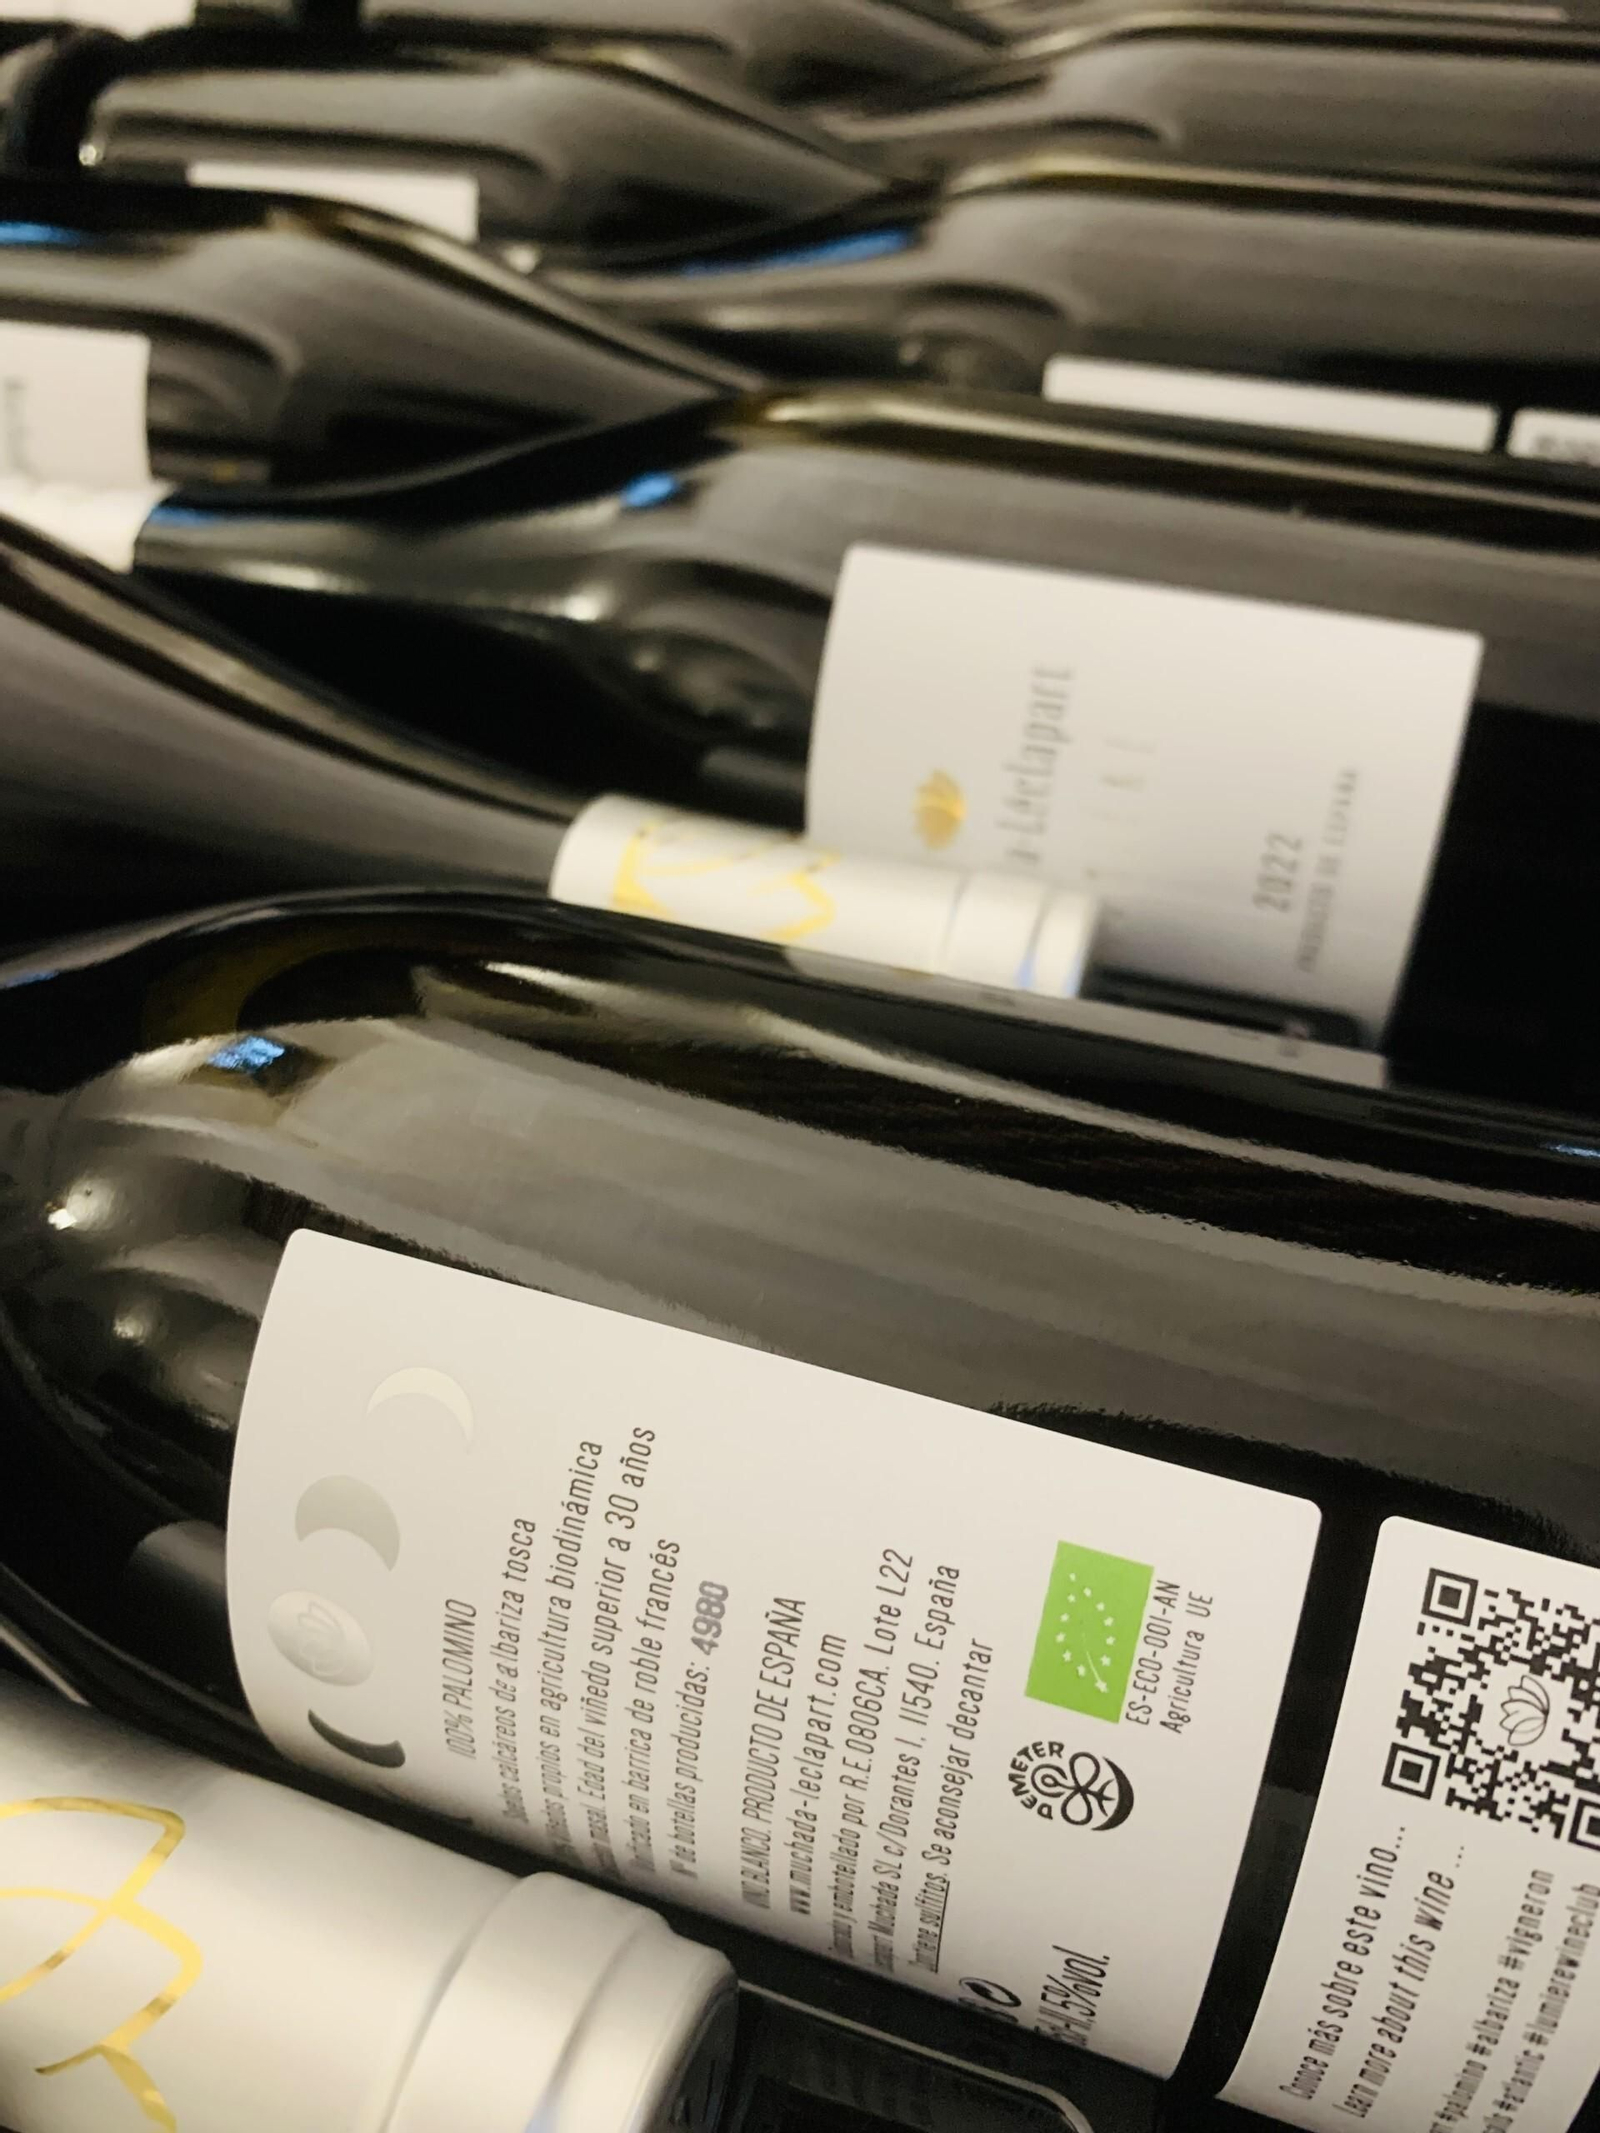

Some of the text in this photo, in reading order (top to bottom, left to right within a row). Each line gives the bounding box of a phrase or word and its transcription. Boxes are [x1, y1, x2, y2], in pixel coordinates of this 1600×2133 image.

[619, 1427, 656, 1488] años
[544, 1441, 603, 1590] biodinámica
[604, 1493, 639, 1530] 30
[501, 1518, 536, 1583] tosca
[607, 1537, 632, 1553] a
[875, 1548, 914, 1597] L22
[591, 1556, 626, 1656] superior
[635, 1538, 680, 1631] francés
[913, 1565, 960, 1651] España
[489, 1589, 525, 1679] albariza
[690, 1580, 729, 1656] 4980
[758, 1597, 806, 1689] ESPAÑA
[863, 1603, 902, 1656] Lote
[441, 1598, 477, 1760] 100% PALOMINO
[537, 1595, 572, 1712] agricultura
[629, 1636, 663, 1694] roble
[1125, 1579, 1181, 1726] ES-ECO-001-AN
[1158, 1590, 1214, 1735] Agricultura UE
[488, 1678, 517, 1703] de
[580, 1660, 611, 1726] viñedo
[624, 1698, 655, 1724] de
[753, 1688, 789, 1723] DE
[898, 1661, 940, 1726] 11540.
[945, 1637, 993, 1741] decantar
[492, 1705, 520, 1783] calcáreos
[539, 1715, 561, 1738] en
[576, 1727, 606, 1759] del
[670, 1661, 710, 1783] producidas:
[838, 1666, 890, 1791] R.E.0806CA.
[537, 1740, 569, 1800] propios
[577, 1758, 606, 1802] Edad
[621, 1728, 653, 1792] barrica
[741, 1723, 783, 1825] PRODUCTO
[783, 1633, 847, 1915] www.muchada-leclapart.com
[933, 1743, 974, 1841] aconsejar
[1007, 1740, 1065, 1821] DEMETER
[628, 1793, 650, 1814] en
[666, 1782, 696, 1846] botellas
[841, 1793, 869, 1828] por
[876, 1753, 921, 1858] c/Dorantes
[740, 1826, 772, 1885] BLANCO.
[872, 1859, 903, 1880] SL
[921, 1843, 952, 1866] Se
[867, 1881, 899, 1937] Muchada
[914, 1872, 948, 1928] sulfitos.
[1413, 1870, 1455, 1932] wine
[1278, 1826, 1406, 2101] Conoce más sobre este vino...
[1391, 1933, 1436, 1982] this
[1465, 1976, 1521, 2057] #albariza
[1497, 1869, 1555, 1972] #vigneron
[1370, 1980, 1420, 2044] about
[1358, 2042, 1397, 2087] more
[1332, 2083, 1379, 2119] Learn
